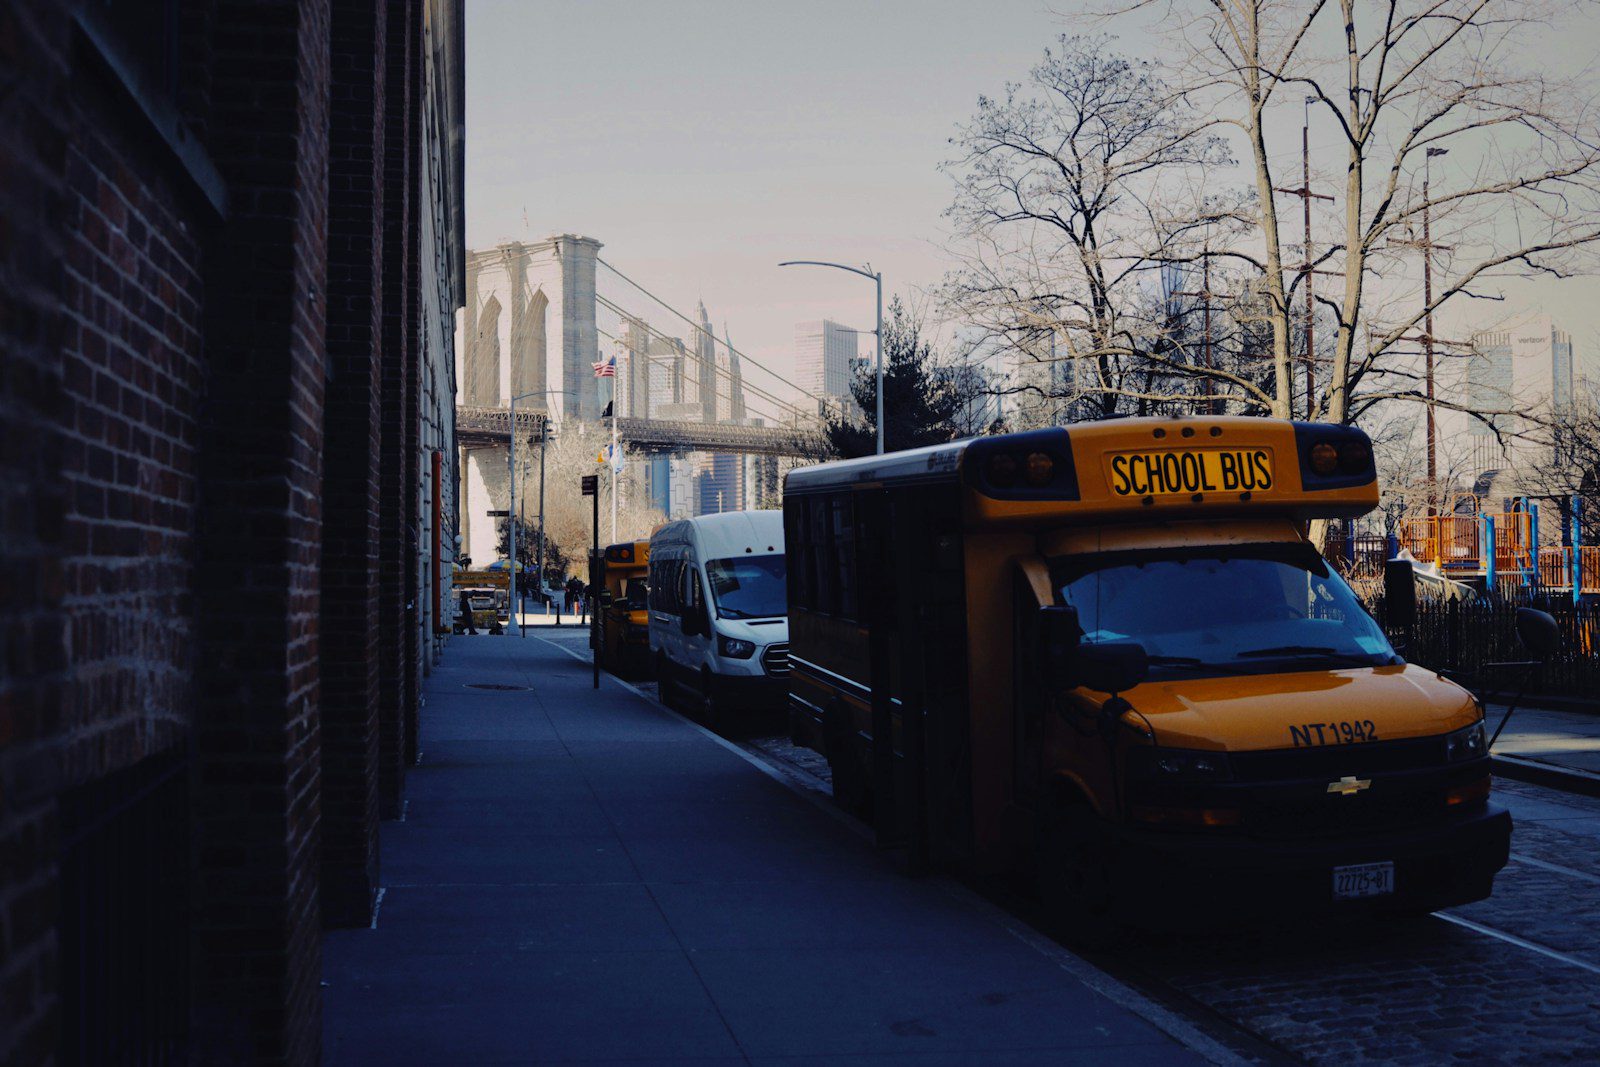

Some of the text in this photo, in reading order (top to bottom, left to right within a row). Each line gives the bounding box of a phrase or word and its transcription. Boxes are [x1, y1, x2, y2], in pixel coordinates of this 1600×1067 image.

[1112, 451, 1271, 495] SCHOOL BUS
[1289, 720, 1378, 746] NT1942
